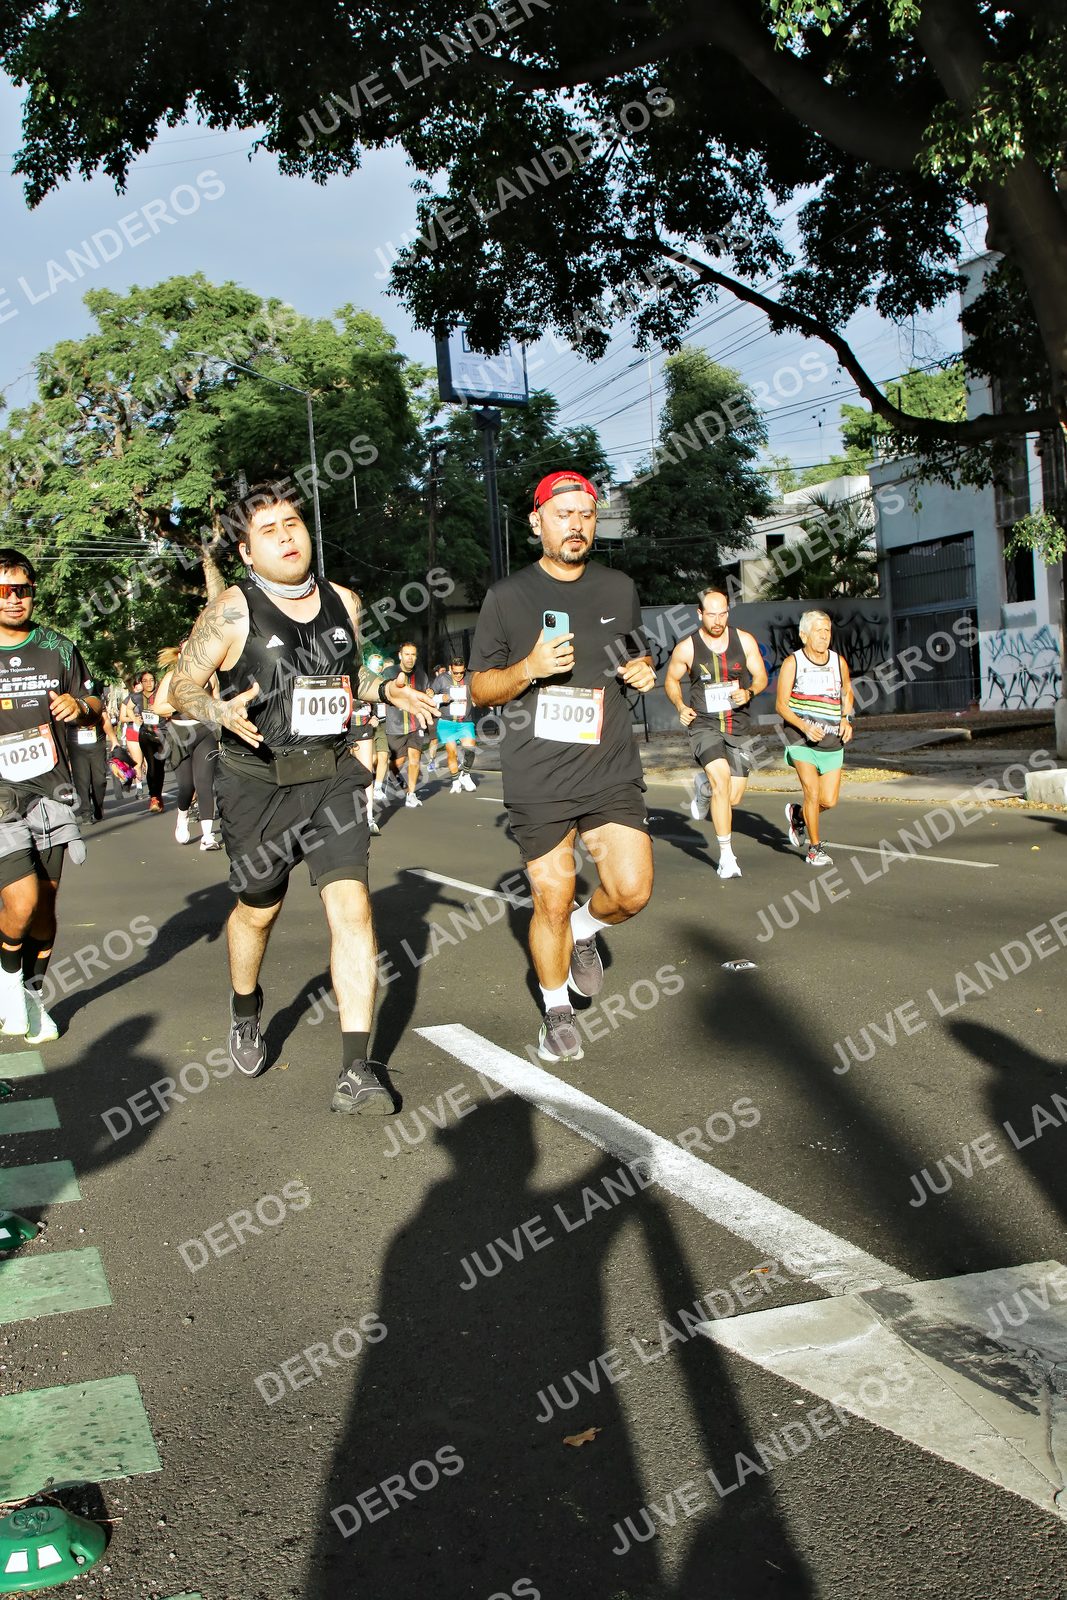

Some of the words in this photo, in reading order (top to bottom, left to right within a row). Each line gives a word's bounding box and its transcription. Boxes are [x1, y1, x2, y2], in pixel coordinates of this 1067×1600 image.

[0, 679, 60, 692] ETISMO
[297, 696, 347, 716] 10169
[541, 702, 595, 723] 13009
[0, 742, 48, 767] 10281
